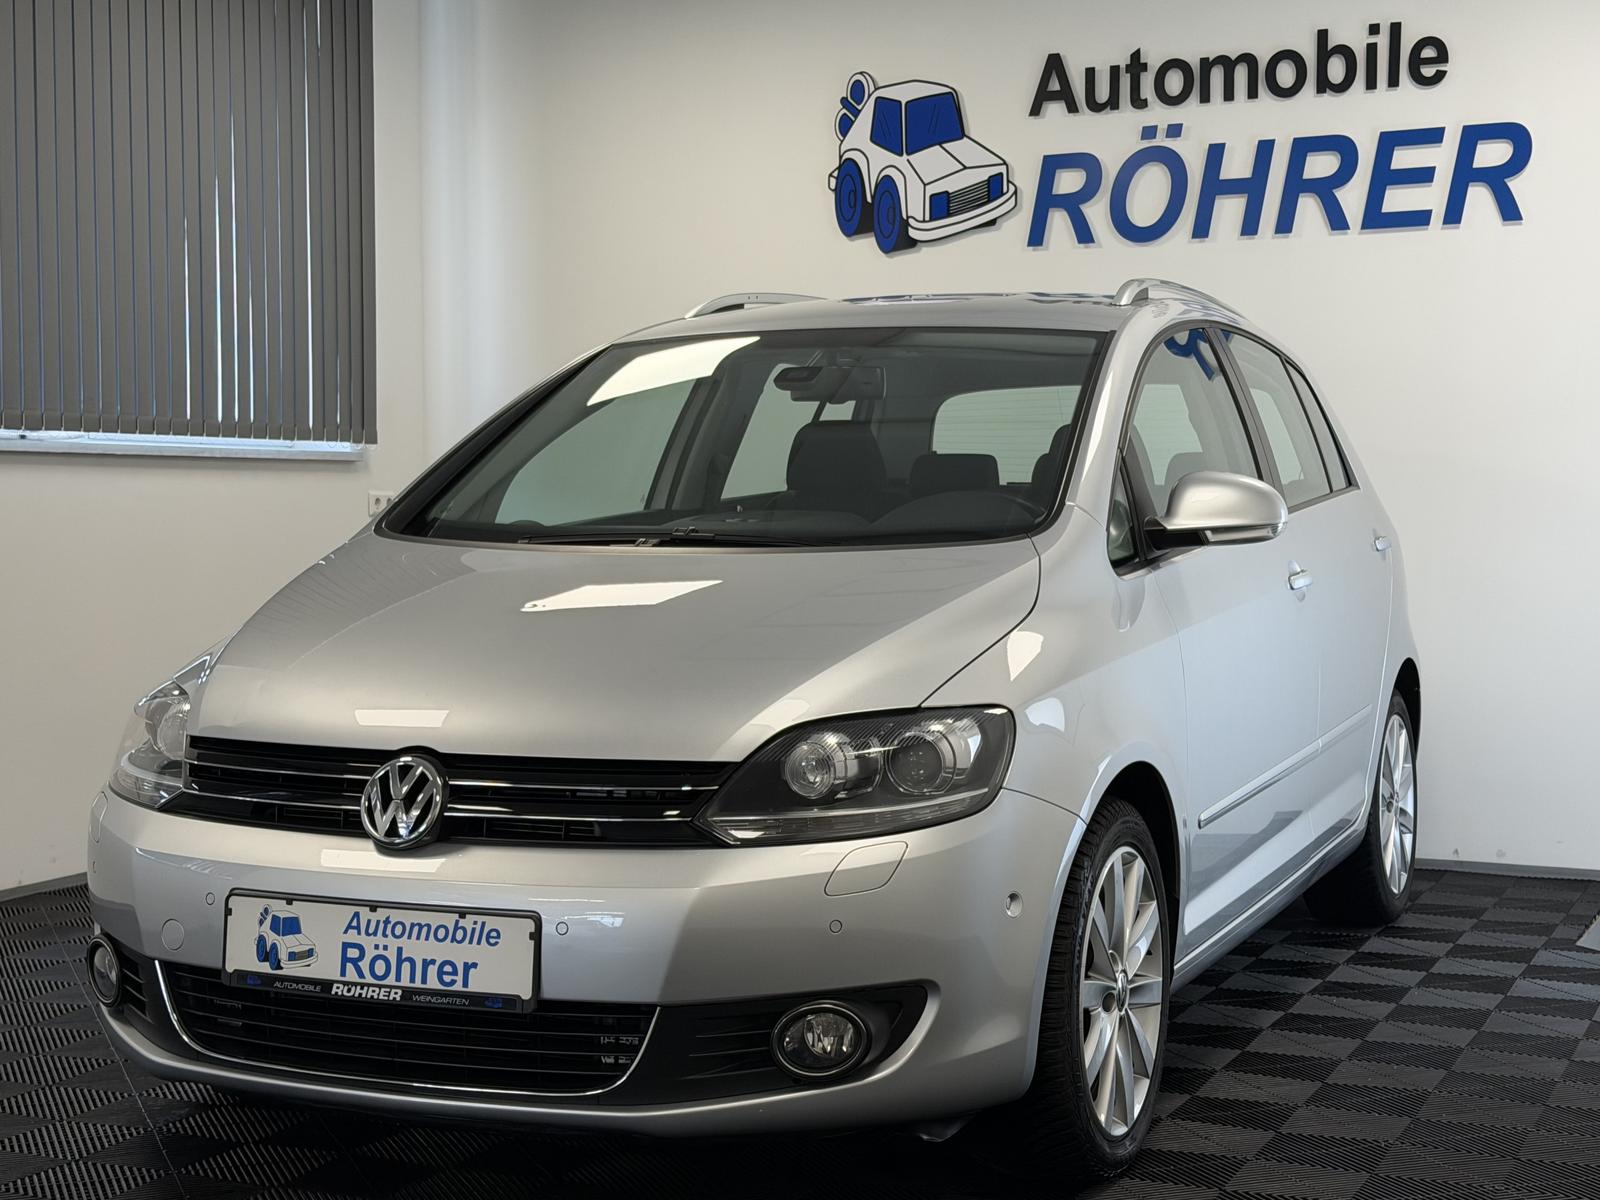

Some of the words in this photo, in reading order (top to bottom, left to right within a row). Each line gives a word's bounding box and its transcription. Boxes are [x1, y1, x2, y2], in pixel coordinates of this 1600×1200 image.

[1029, 22, 1449, 117] Automobile
[1027, 122, 1533, 248] RÖHRER
[343, 911, 501, 946] Automobile
[339, 942, 479, 989] Röhrer
[273, 981, 322, 993] AUTOMOBILE
[331, 983, 402, 1001] RÖHRER
[412, 994, 470, 1006] WEINGARTEN
